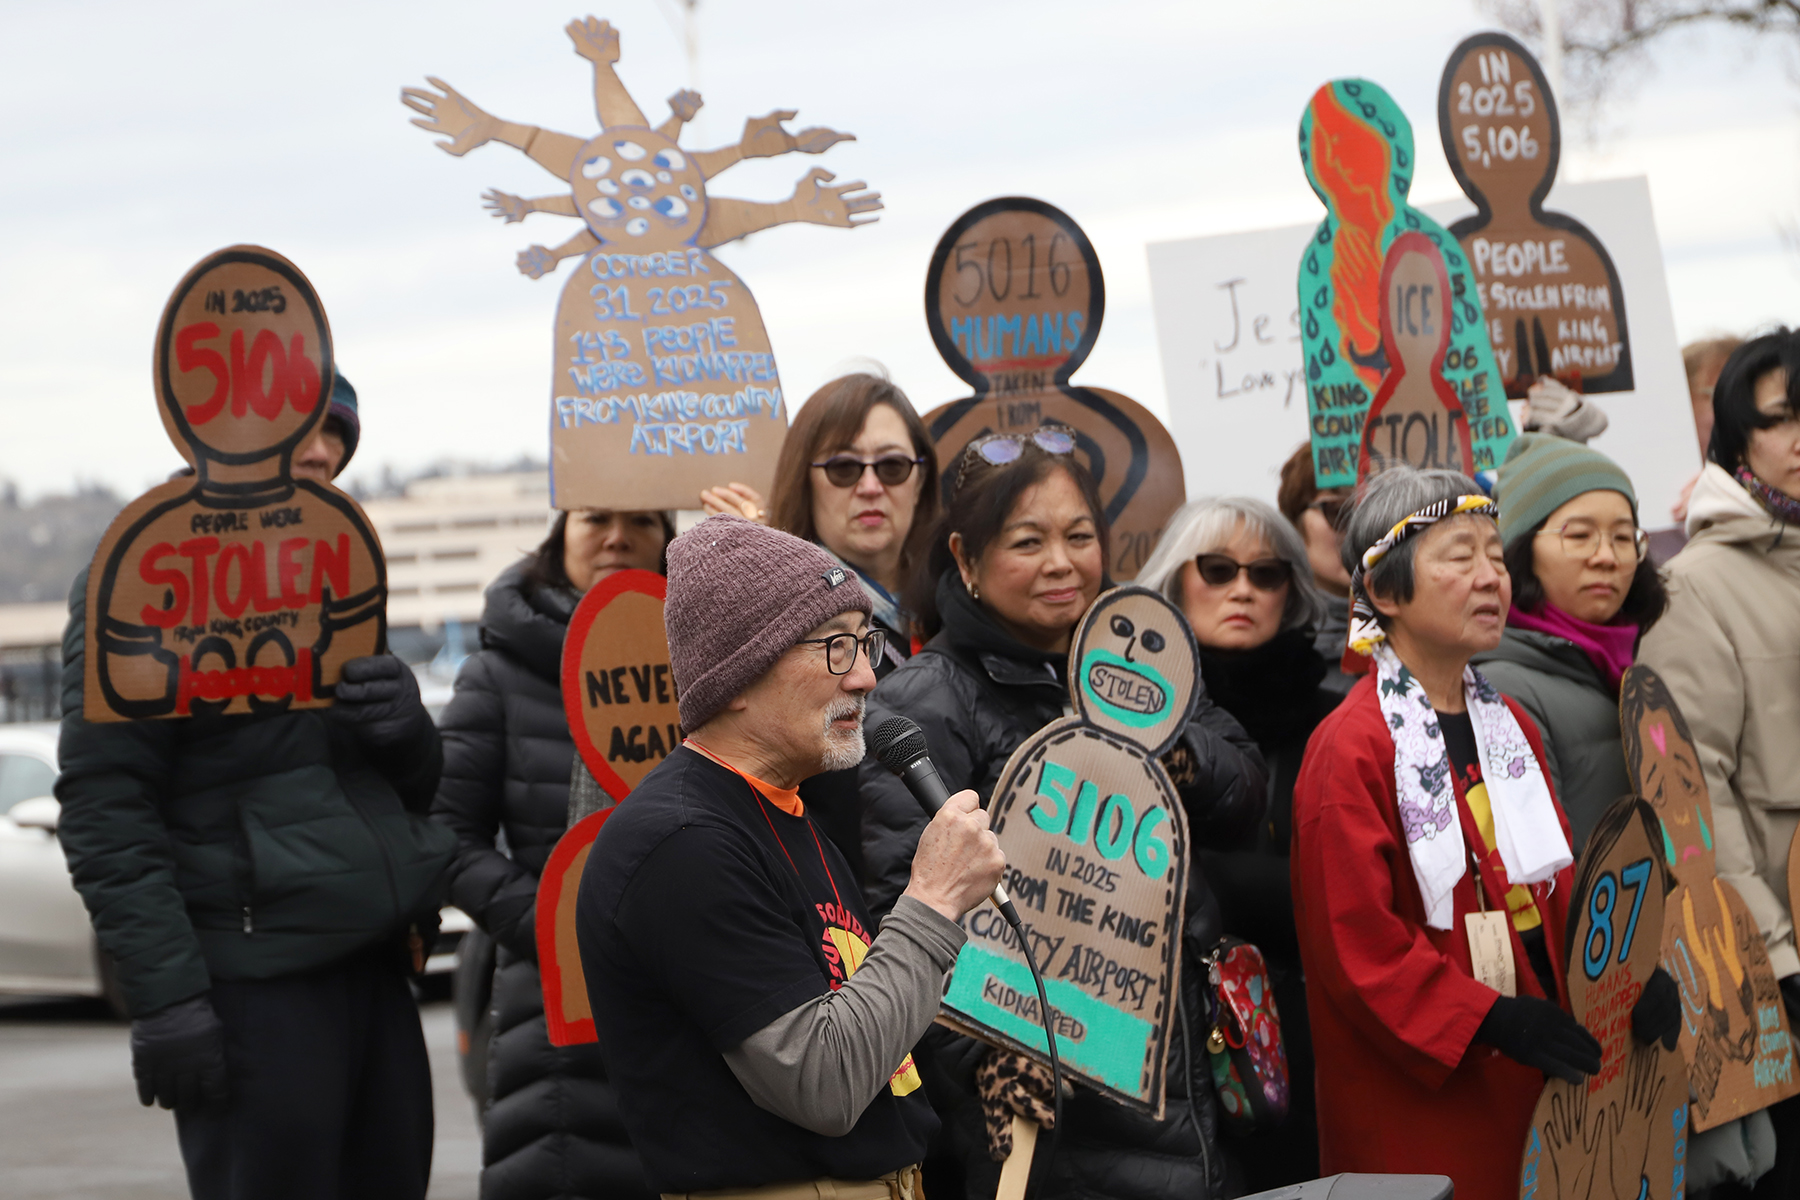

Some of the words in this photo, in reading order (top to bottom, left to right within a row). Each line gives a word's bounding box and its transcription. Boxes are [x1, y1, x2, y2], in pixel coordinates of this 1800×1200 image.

[1478, 51, 1512, 85] IN
[1458, 81, 1535, 117] 2025
[1462, 124, 1539, 169] 5,106
[591, 248, 710, 280] OCTOBER
[953, 231, 1072, 308] 5016
[1472, 238, 1570, 276] PEOPLE
[204, 290, 226, 315] IN
[231, 287, 287, 314] 2025
[646, 280, 733, 315] 2025
[1396, 284, 1435, 336] ICE
[1561, 282, 1611, 311] FROM
[570, 329, 631, 365] 143
[951, 311, 1083, 361] HUMANS
[1557, 315, 1609, 344] KING
[175, 322, 321, 425] 5106
[651, 352, 778, 387] KIDNAPPED
[991, 371, 1045, 396] TAKEN
[555, 396, 642, 429] FROM
[638, 390, 699, 423] KING
[699, 385, 783, 420] COUNTY
[997, 401, 1041, 429] FROM
[1312, 382, 1368, 411] KING
[629, 418, 751, 457] AIRPORT
[191, 512, 248, 533] PEOPLE
[259, 507, 303, 529] WERE
[1116, 529, 1163, 573] 20
[139, 533, 350, 628] STOLEN
[586, 664, 679, 708] NEVE
[1091, 665, 1163, 713] STOLEN
[1027, 760, 1170, 880] 5106
[1045, 847, 1070, 876] IN
[1071, 856, 1121, 893] 2025
[1002, 864, 1048, 913] FROM
[1057, 887, 1096, 925] THE
[1098, 905, 1158, 948] KING
[1583, 857, 1653, 982] 87
[970, 908, 1065, 976] COUNTY
[1058, 944, 1157, 1011] AIRPORT
[1585, 962, 1632, 1006] HUMANS
